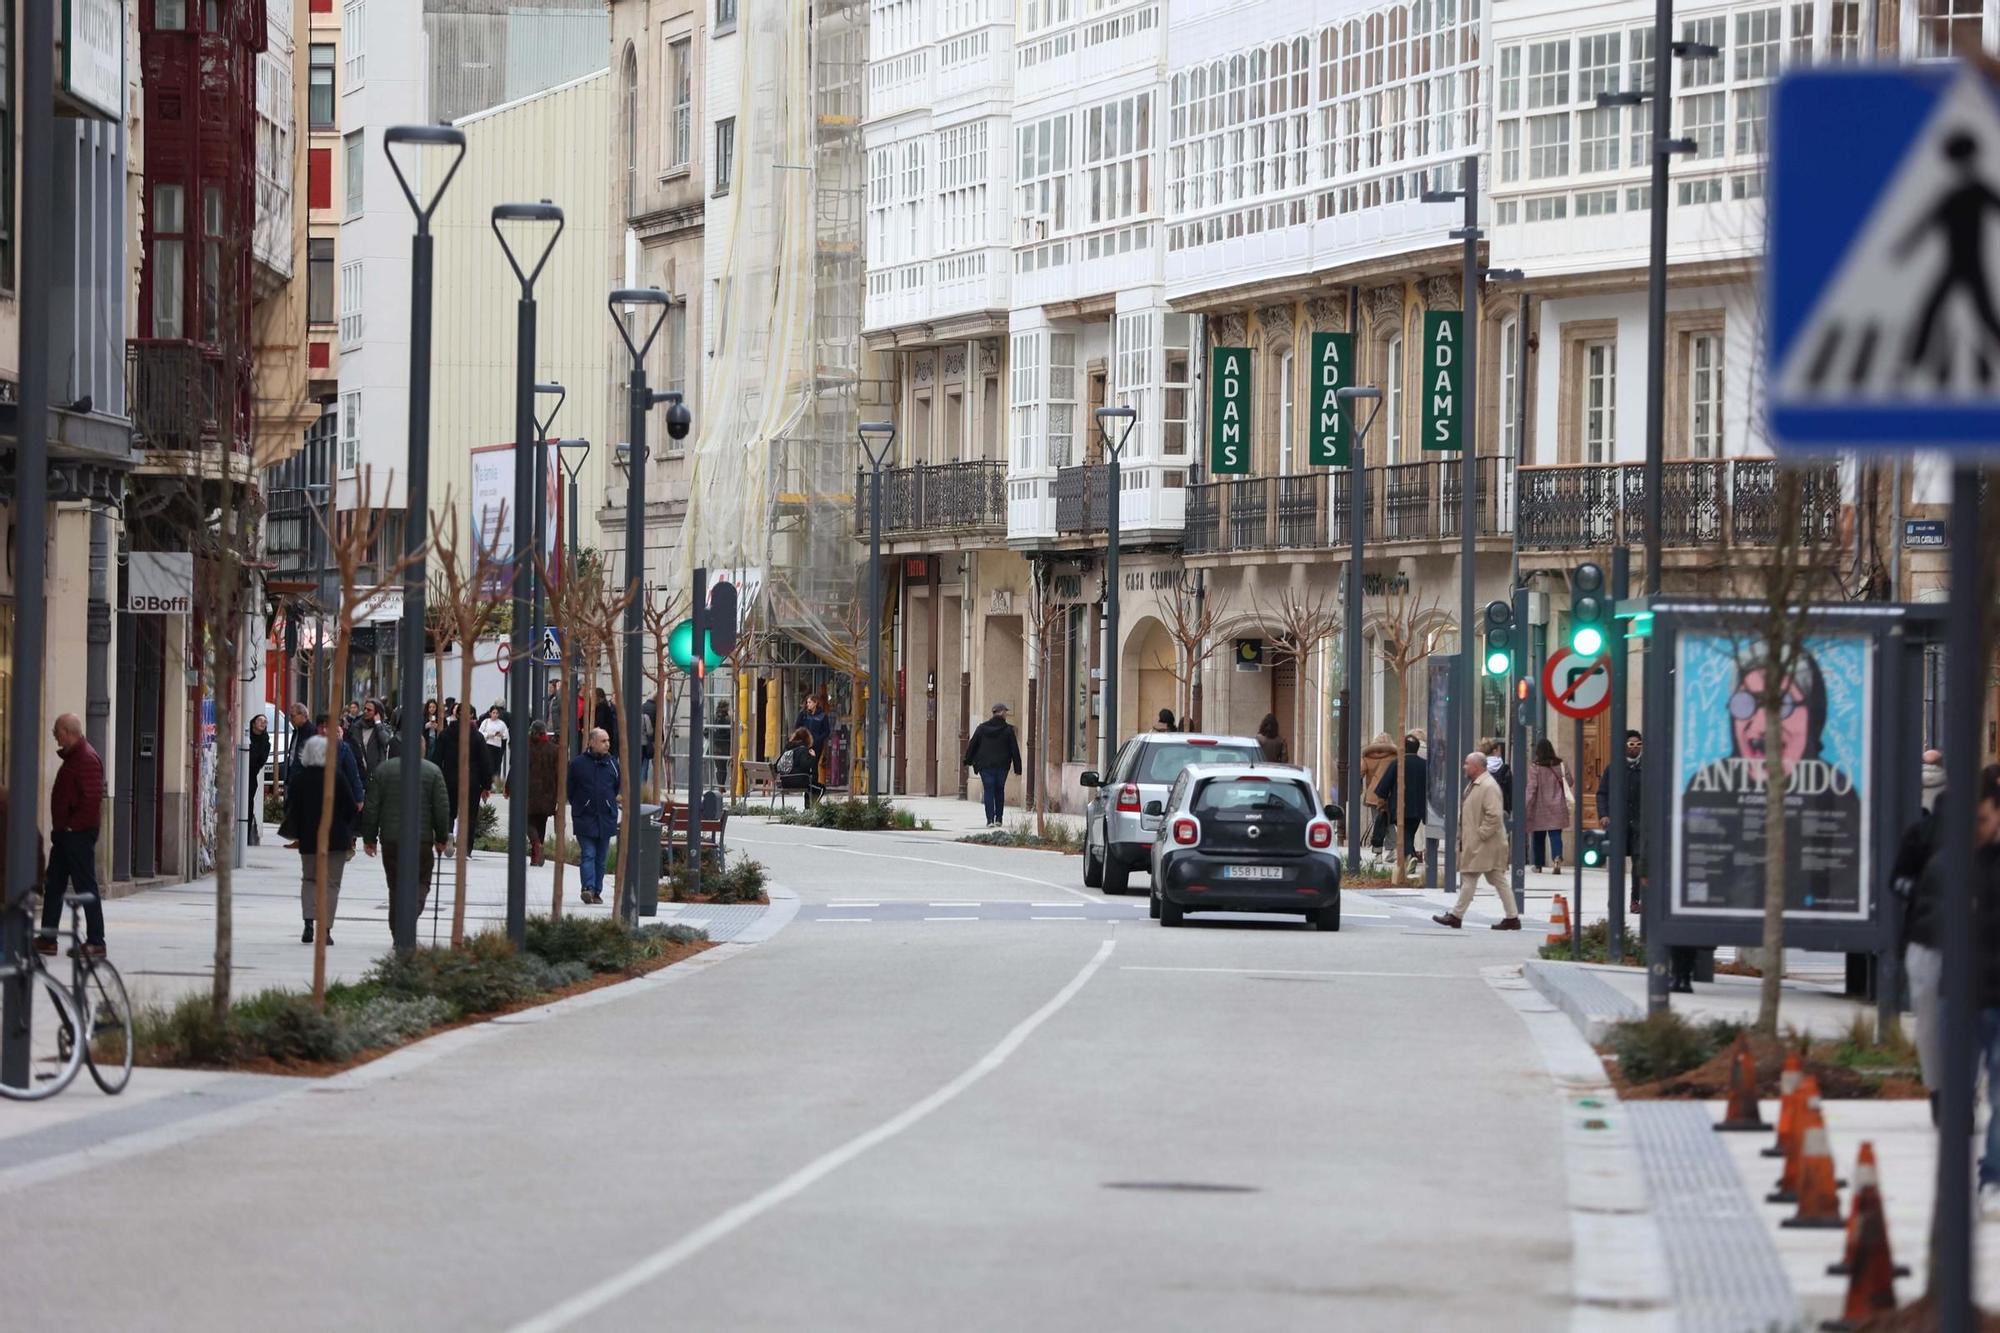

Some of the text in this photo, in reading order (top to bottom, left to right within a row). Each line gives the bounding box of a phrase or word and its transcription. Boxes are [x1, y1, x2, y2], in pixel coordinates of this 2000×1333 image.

[1434, 320, 1453, 441] ADAMS
[1321, 341, 1339, 457] ADAMS
[1222, 355, 1240, 466] ADAMS
[1921, 535, 1943, 544] CATALINA
[1125, 572, 1145, 591] CASA
[148, 596, 188, 611] Boffi
[1231, 866, 1281, 878] 5581 LLZ
